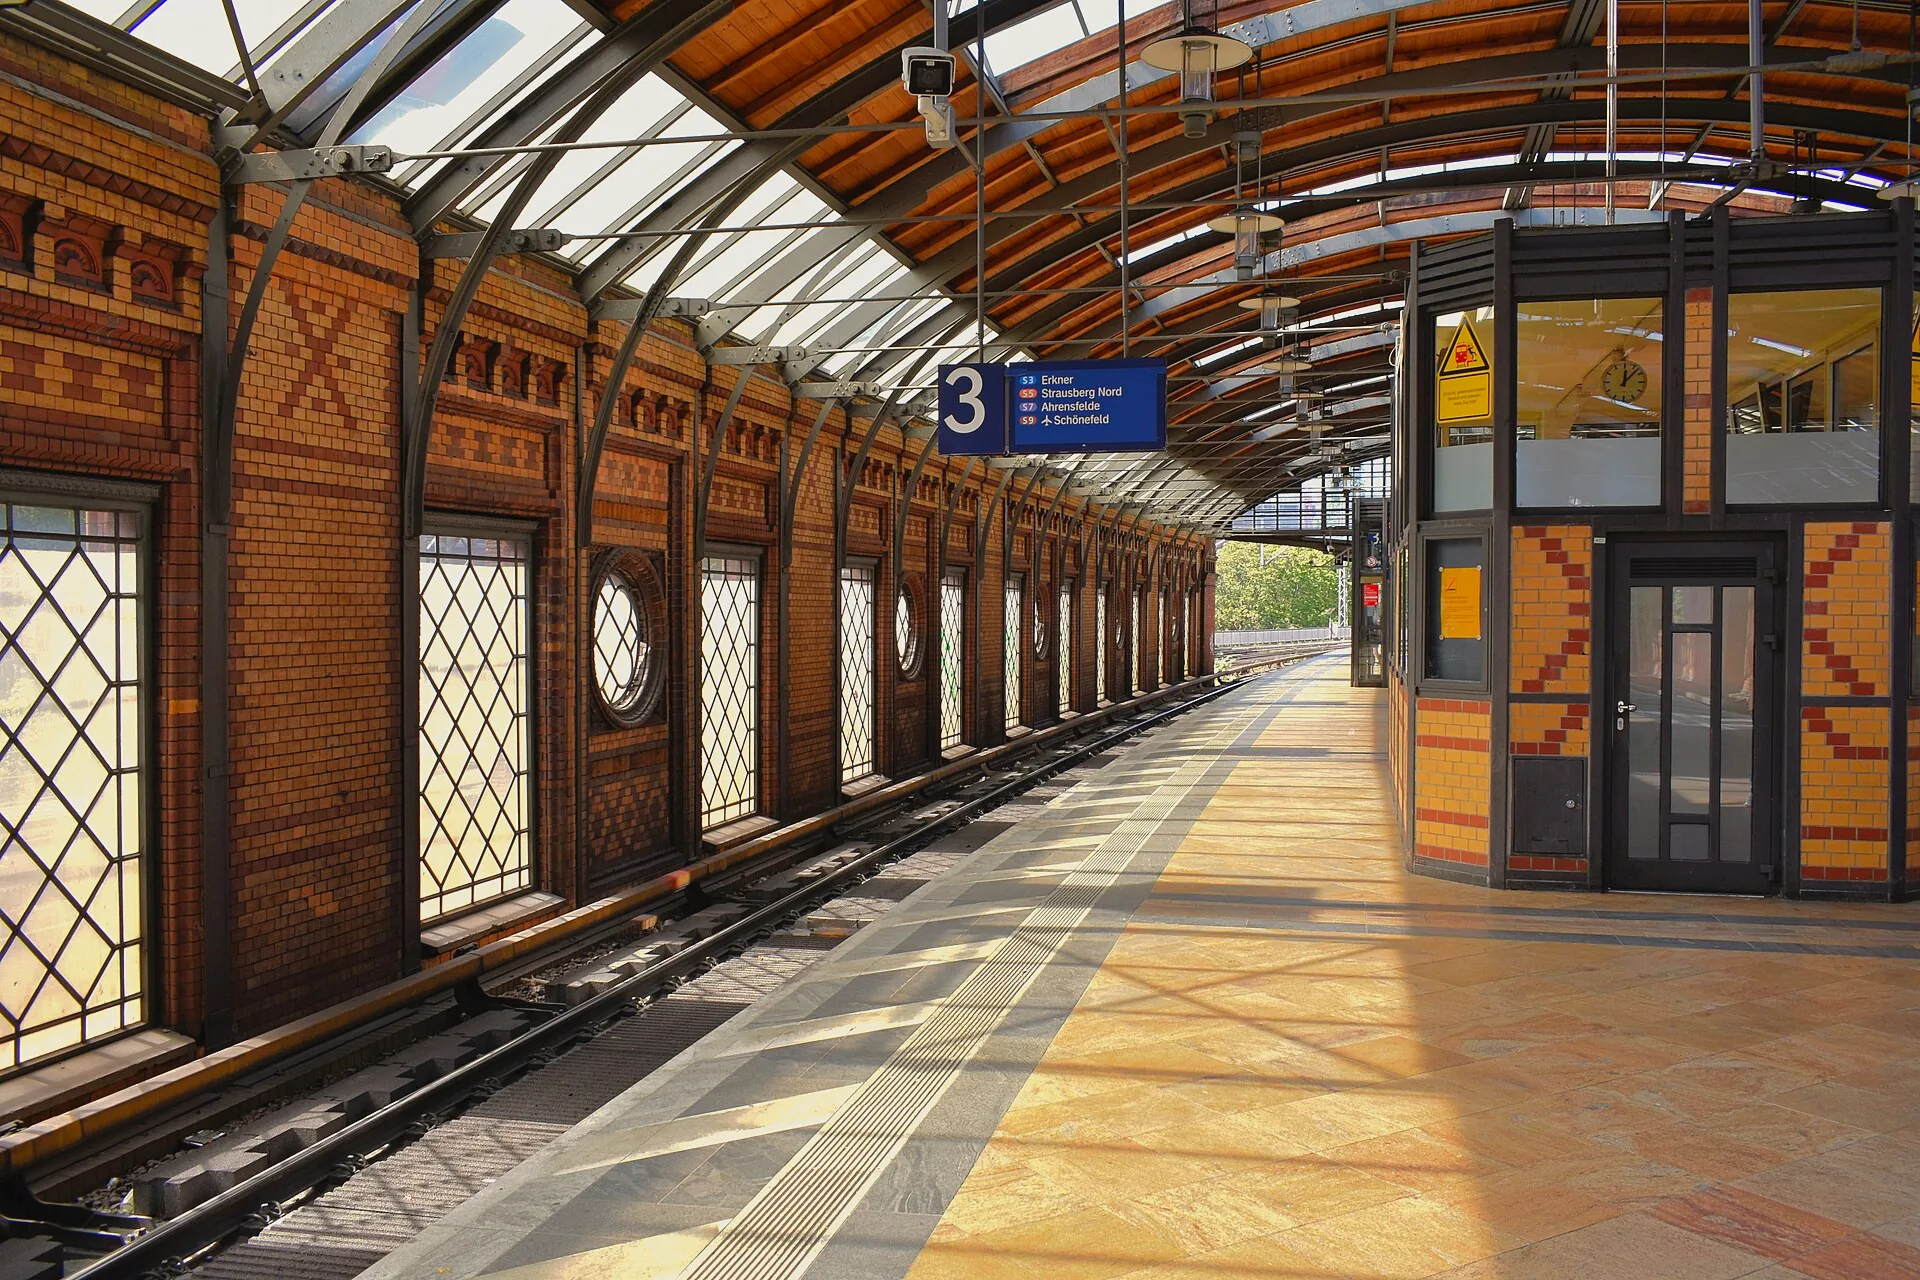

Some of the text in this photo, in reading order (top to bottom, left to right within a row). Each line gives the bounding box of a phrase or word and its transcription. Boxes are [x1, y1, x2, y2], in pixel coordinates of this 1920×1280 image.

[1022, 375, 1074, 385] S3 Erkner
[1022, 386, 1122, 400] S5 Strausberg Nord
[943, 366, 986, 434] 3
[1022, 401, 1101, 412] S7 Ahrensfelde
[1022, 414, 1110, 425] S9 Schönefeld
